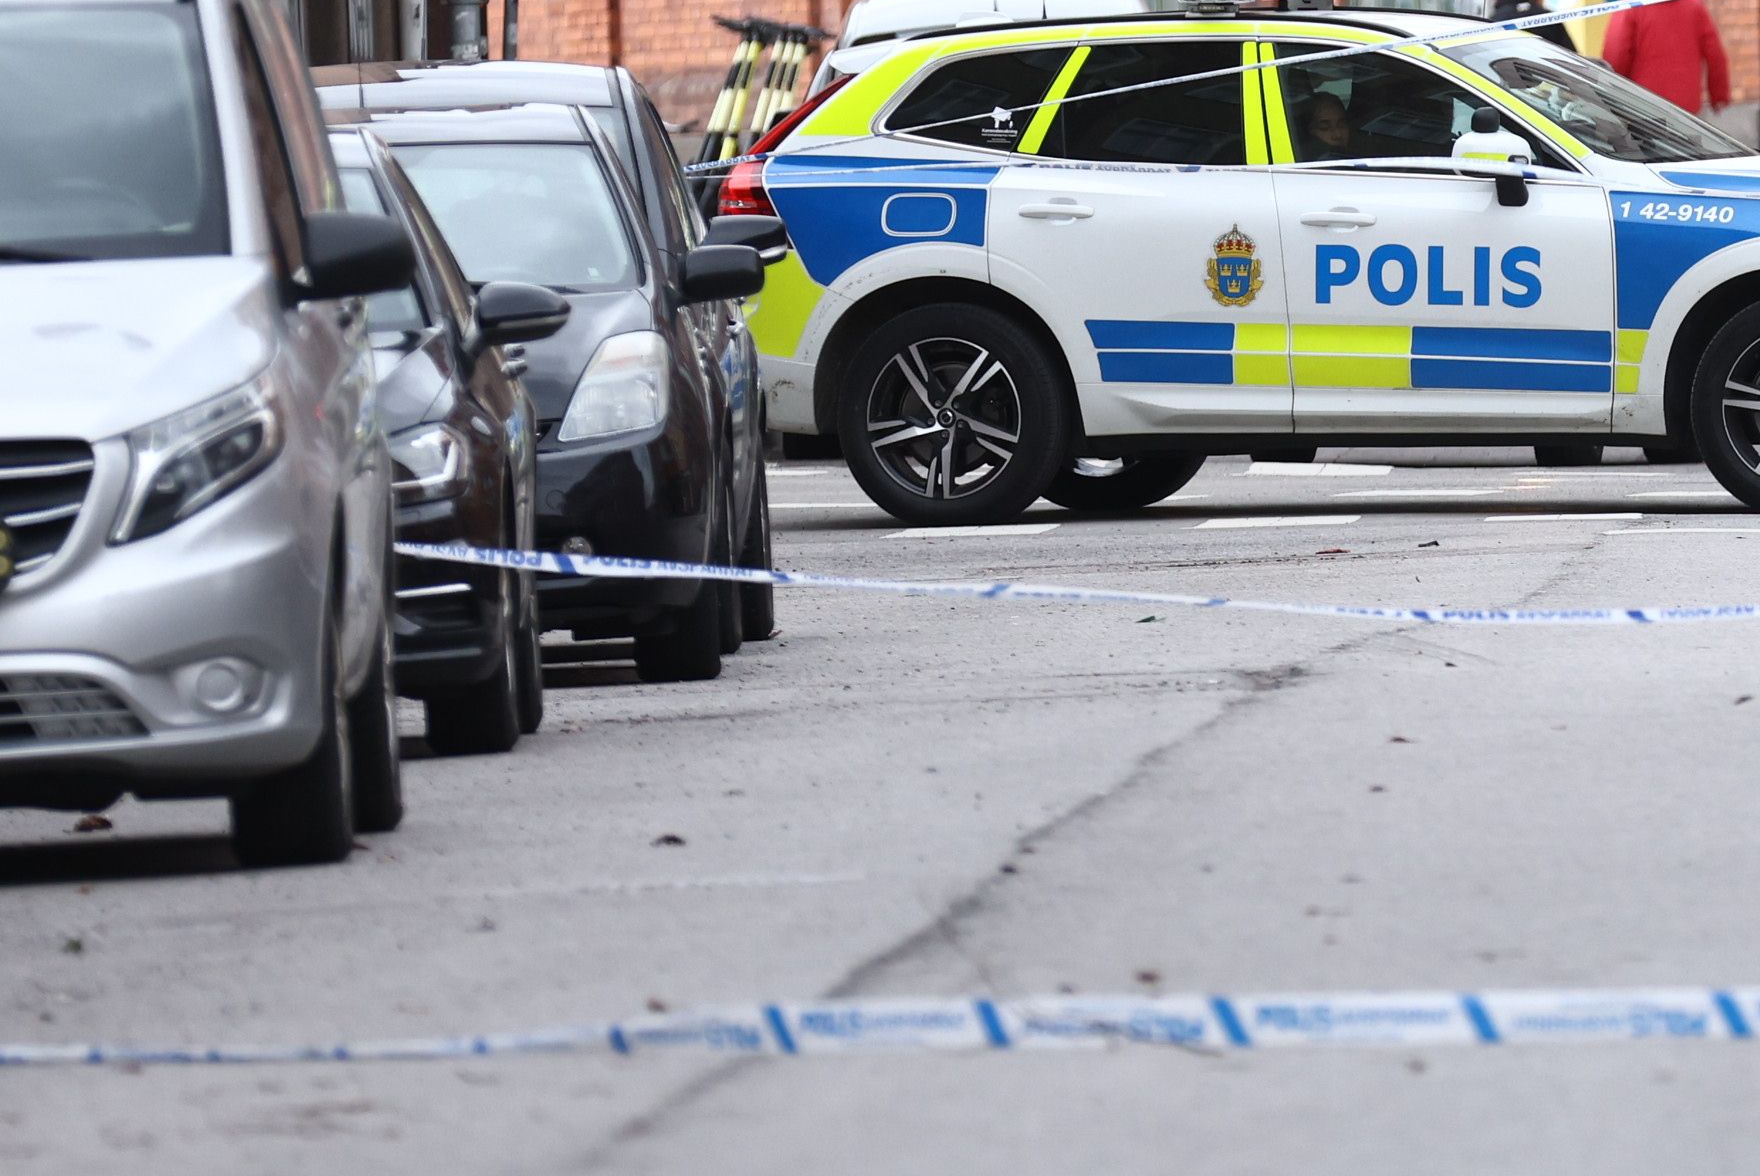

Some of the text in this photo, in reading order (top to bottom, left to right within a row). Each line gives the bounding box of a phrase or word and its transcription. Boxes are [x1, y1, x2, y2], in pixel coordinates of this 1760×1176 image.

[1620, 201, 1734, 224] 1 42-9140
[1315, 243, 1542, 309] POLIS
